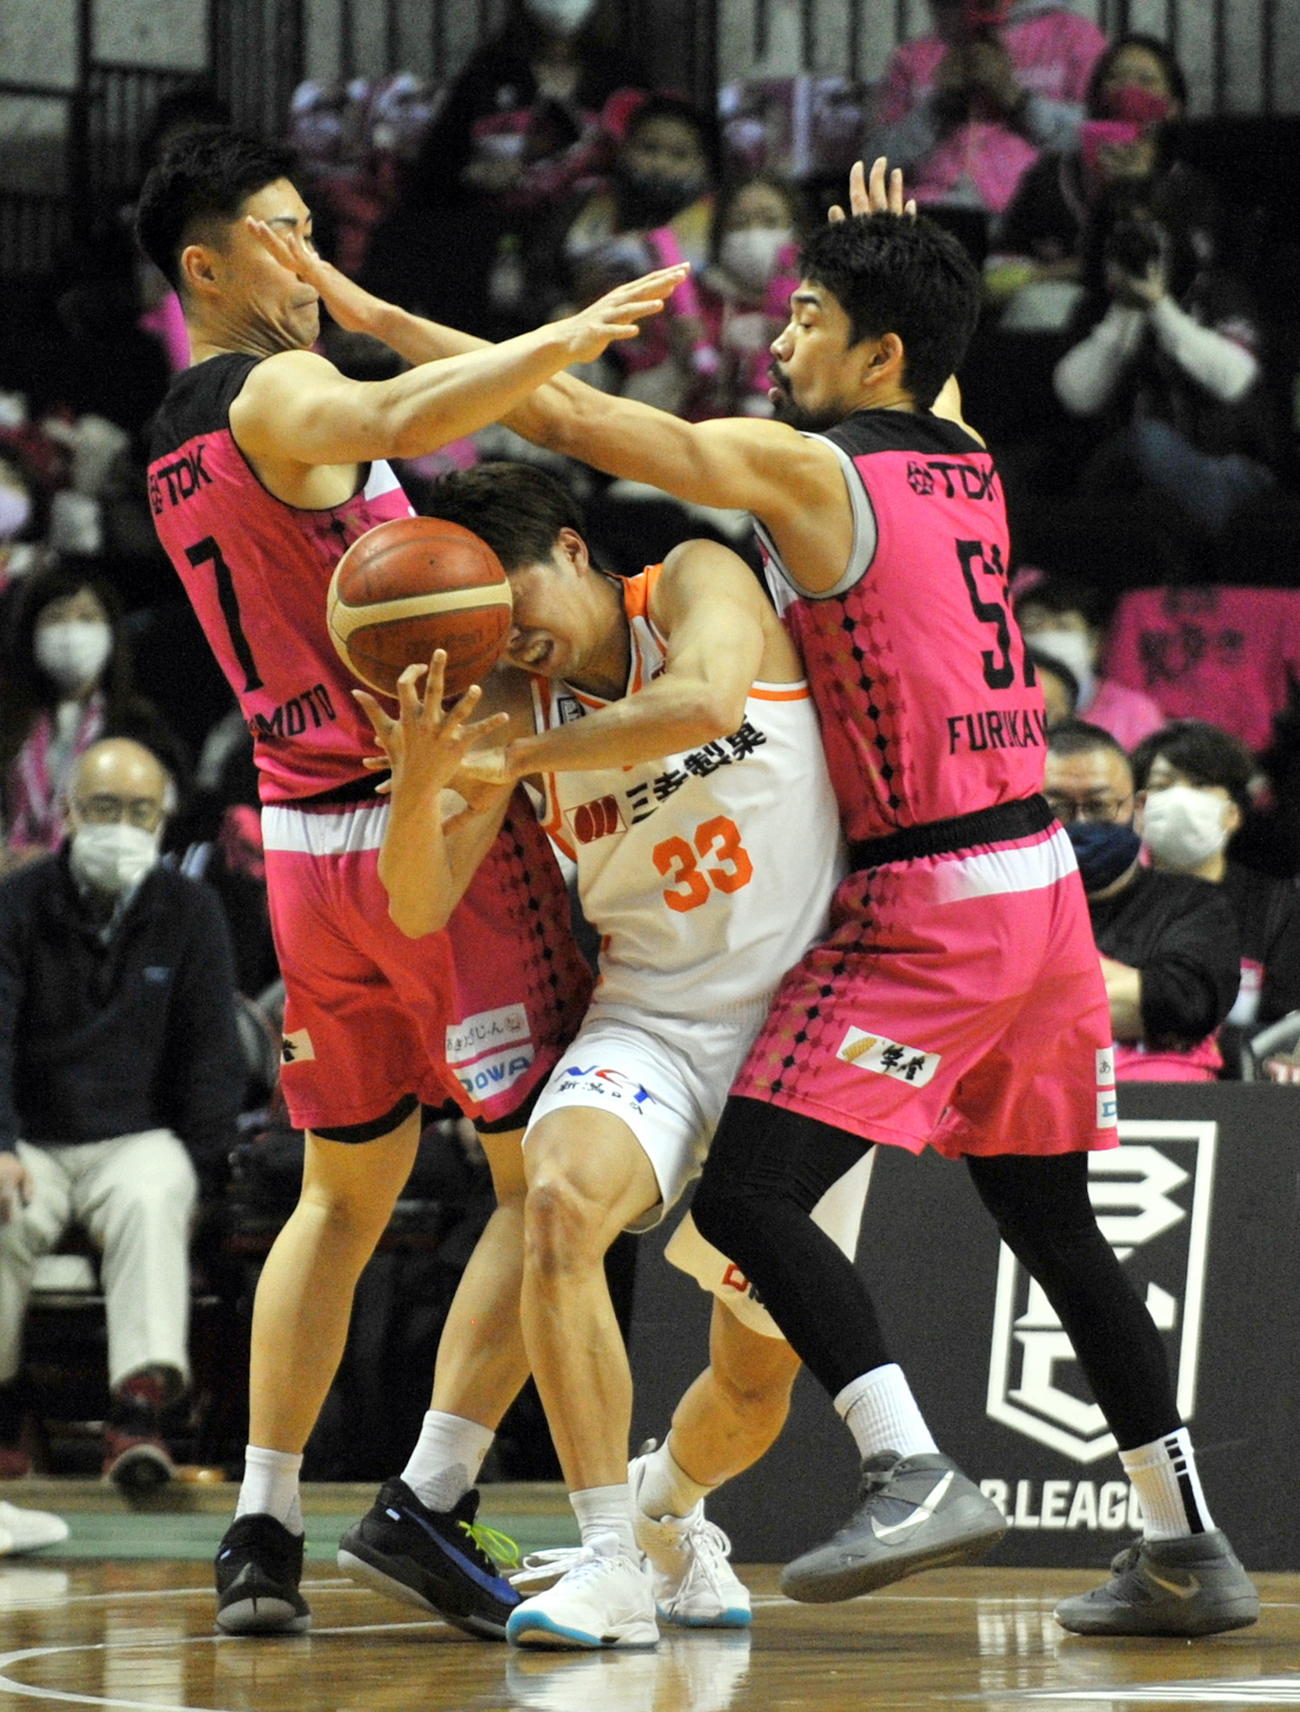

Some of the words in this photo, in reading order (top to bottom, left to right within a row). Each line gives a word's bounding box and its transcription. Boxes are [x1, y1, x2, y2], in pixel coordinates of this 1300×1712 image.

[157, 445, 214, 506] TDK
[185, 535, 265, 693] 7
[250, 683, 336, 741] MOTO
[652, 815, 754, 913] 33
